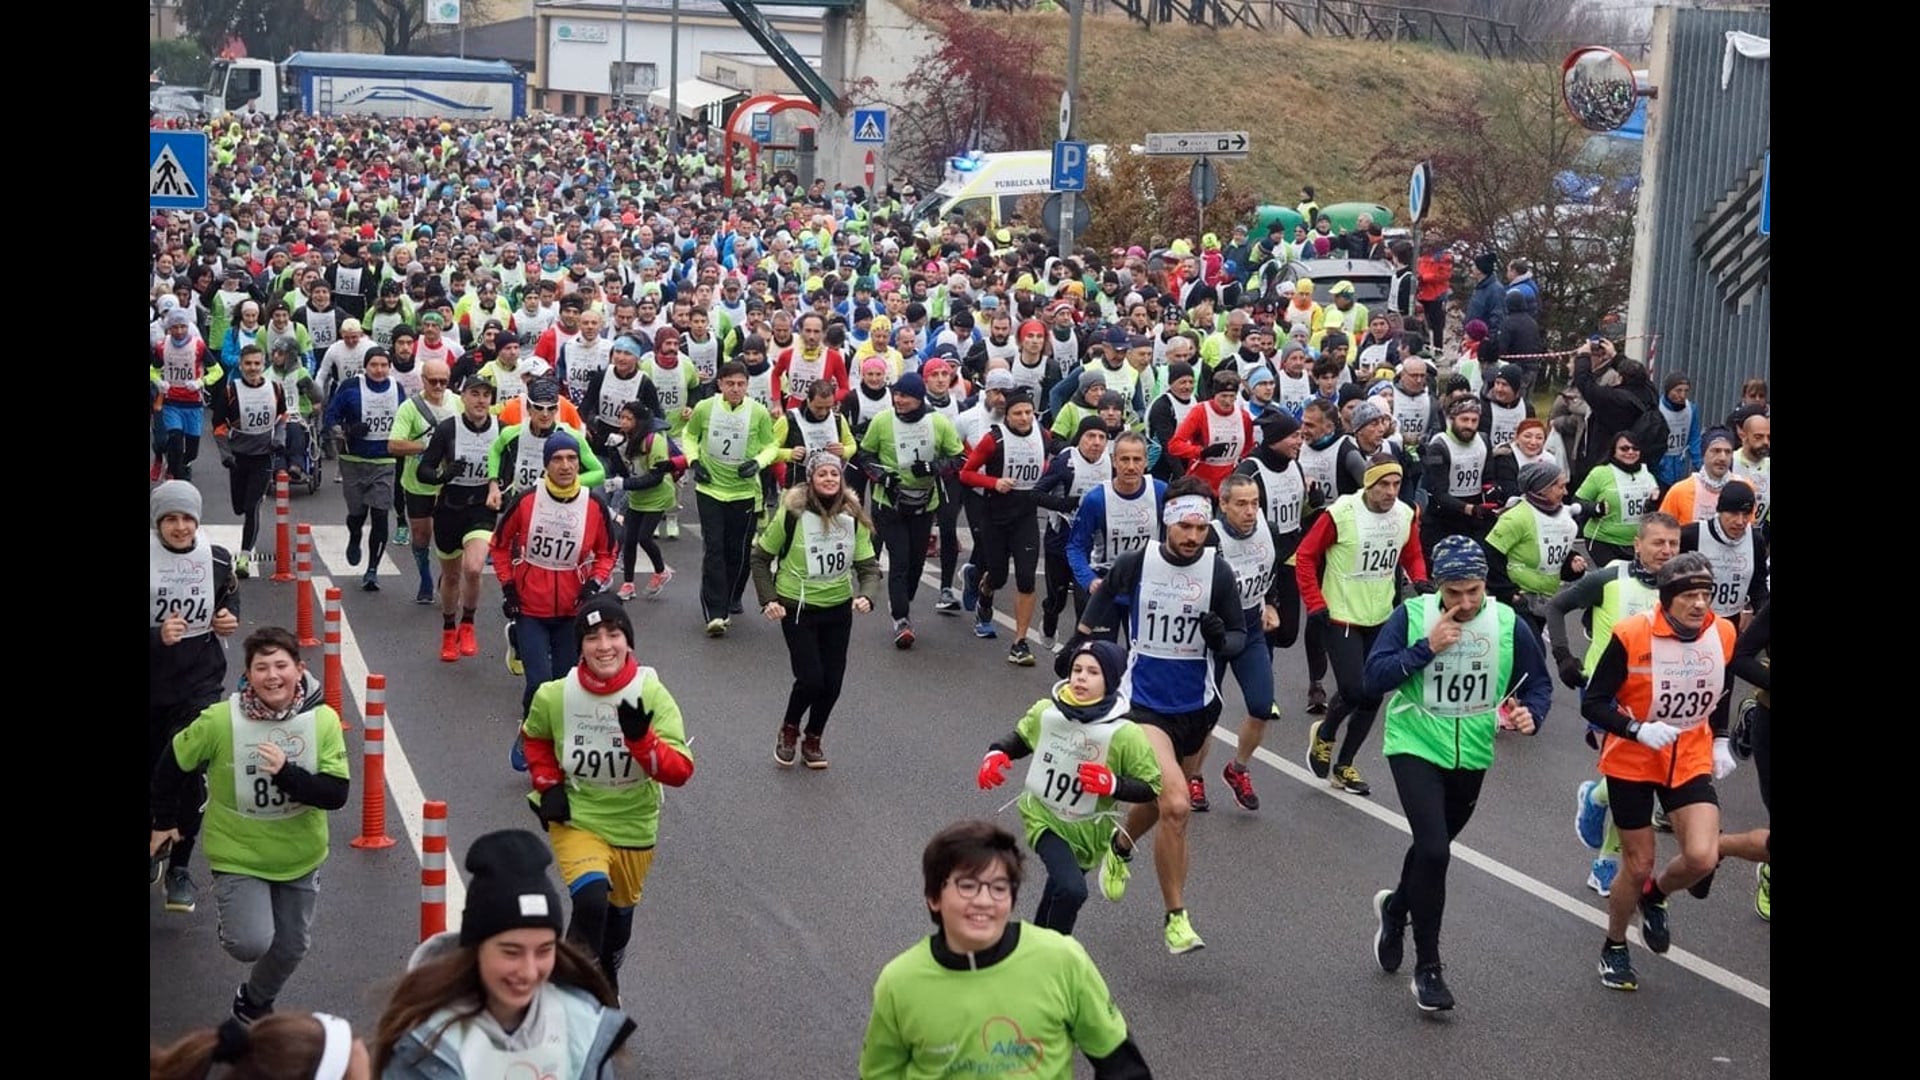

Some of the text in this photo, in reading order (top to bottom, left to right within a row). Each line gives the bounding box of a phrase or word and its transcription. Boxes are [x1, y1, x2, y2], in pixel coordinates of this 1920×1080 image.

[1063, 145, 1081, 174] P
[995, 179, 1033, 188] PUBBLICA
[314, 331, 332, 343] 363
[168, 365, 193, 381] 1706
[248, 411, 270, 427] 268
[365, 416, 393, 433] 2952
[723, 439, 732, 456] 2
[1007, 464, 1039, 483] 1700
[1457, 470, 1479, 488] 999
[531, 535, 576, 561] 3517
[1111, 535, 1151, 556] 1727
[816, 552, 846, 576] 198
[1361, 547, 1398, 572] 1240
[1146, 611, 1201, 645] 1137
[1432, 672, 1488, 702] 1691
[1656, 690, 1713, 720] 3239
[571, 749, 632, 778] 2917
[1043, 767, 1085, 807] 199
